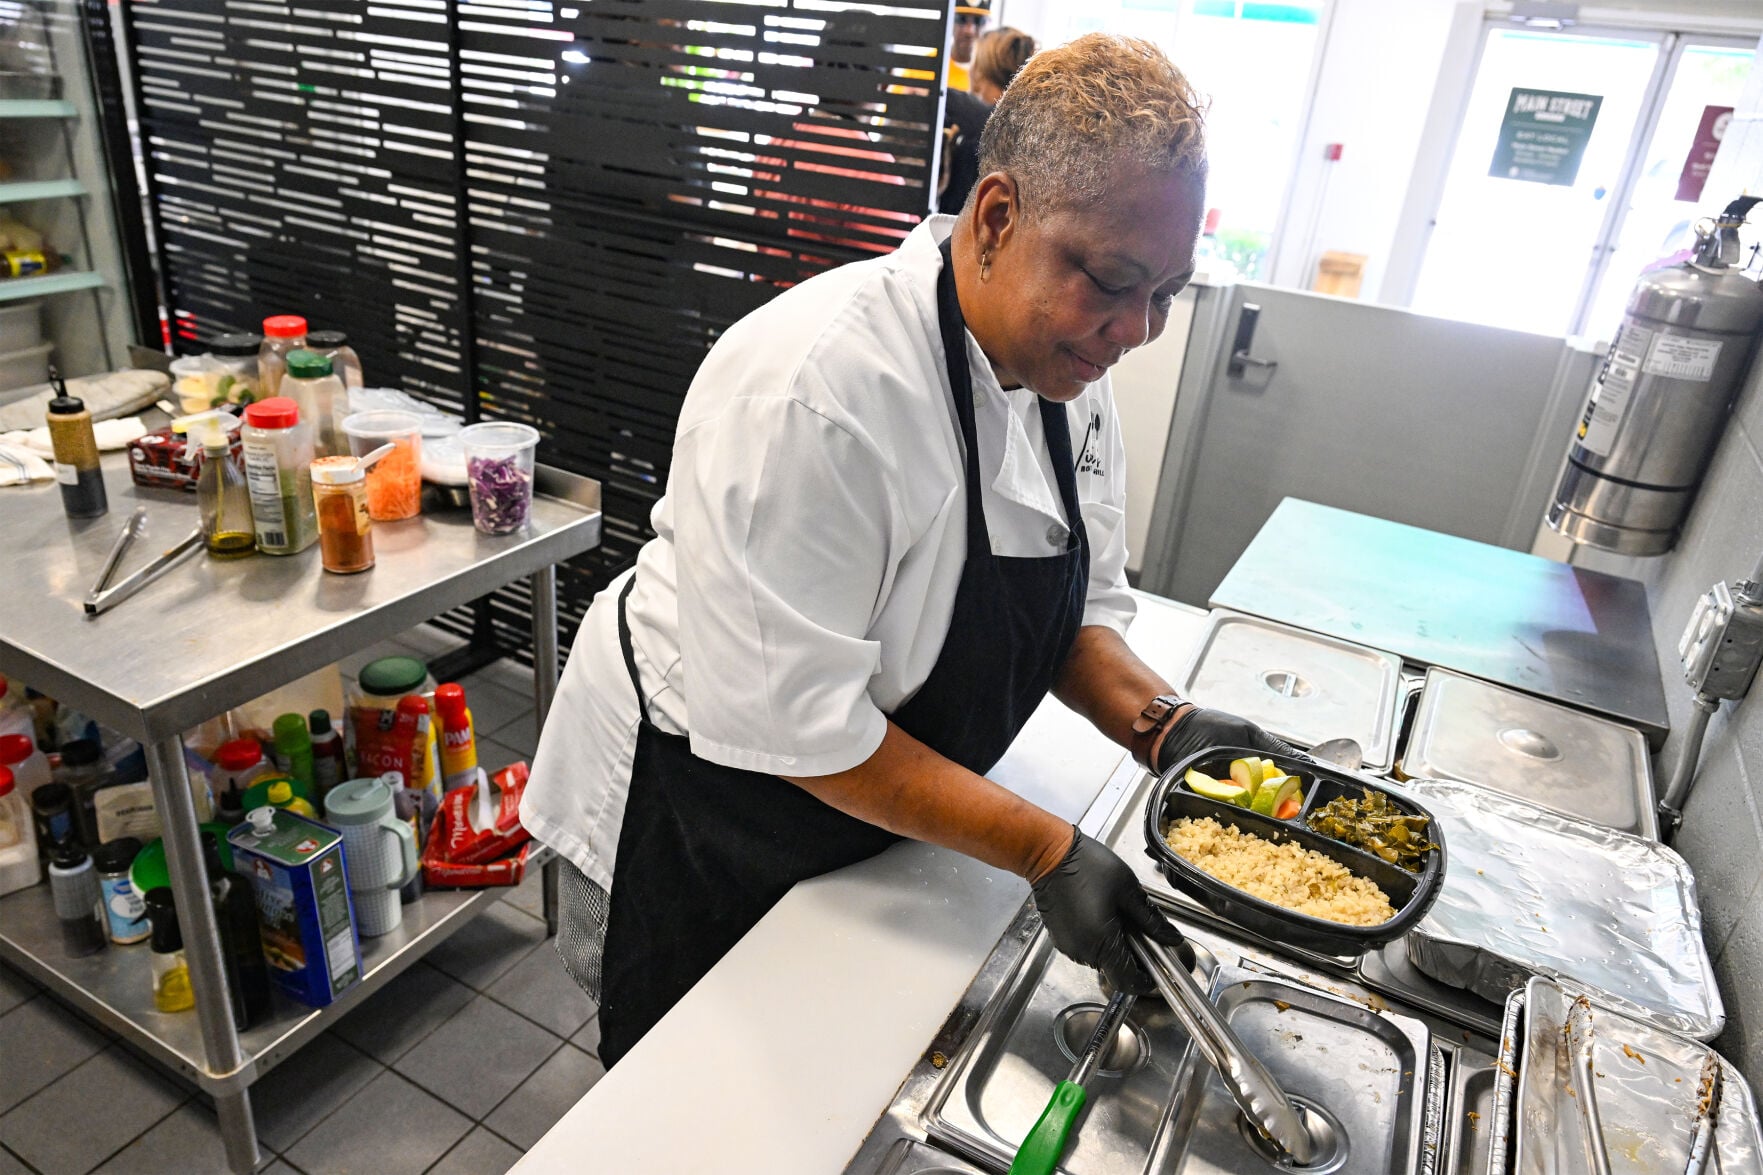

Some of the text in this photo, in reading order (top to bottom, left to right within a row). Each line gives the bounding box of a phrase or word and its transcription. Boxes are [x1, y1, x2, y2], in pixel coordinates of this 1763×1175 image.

[1513, 93, 1549, 114] MAIN
[1548, 97, 1594, 120] STREET
[444, 726, 471, 746] PAM
